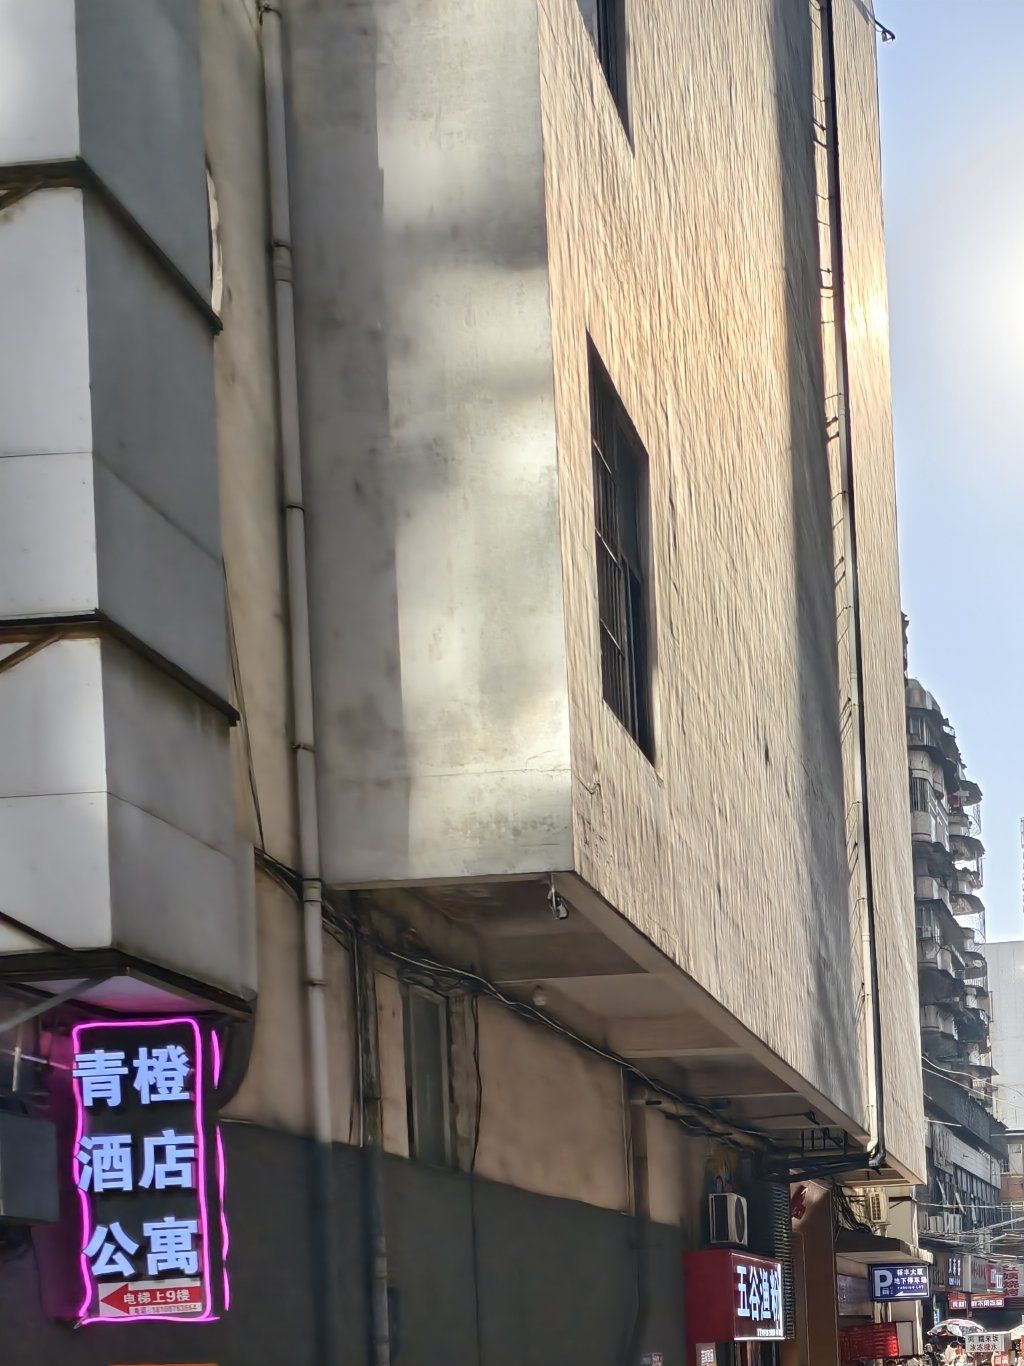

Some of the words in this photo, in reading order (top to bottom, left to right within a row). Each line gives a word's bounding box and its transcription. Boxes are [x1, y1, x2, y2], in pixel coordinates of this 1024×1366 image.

[72, 1045, 191, 1107] 青橙
[75, 1129, 197, 1192] 酒店
[82, 1216, 201, 1277] 公寓
[123, 1289, 190, 1305] 电梯上9楼
[874, 1270, 893, 1297] P
[894, 1276, 927, 1285] 地下停车场
